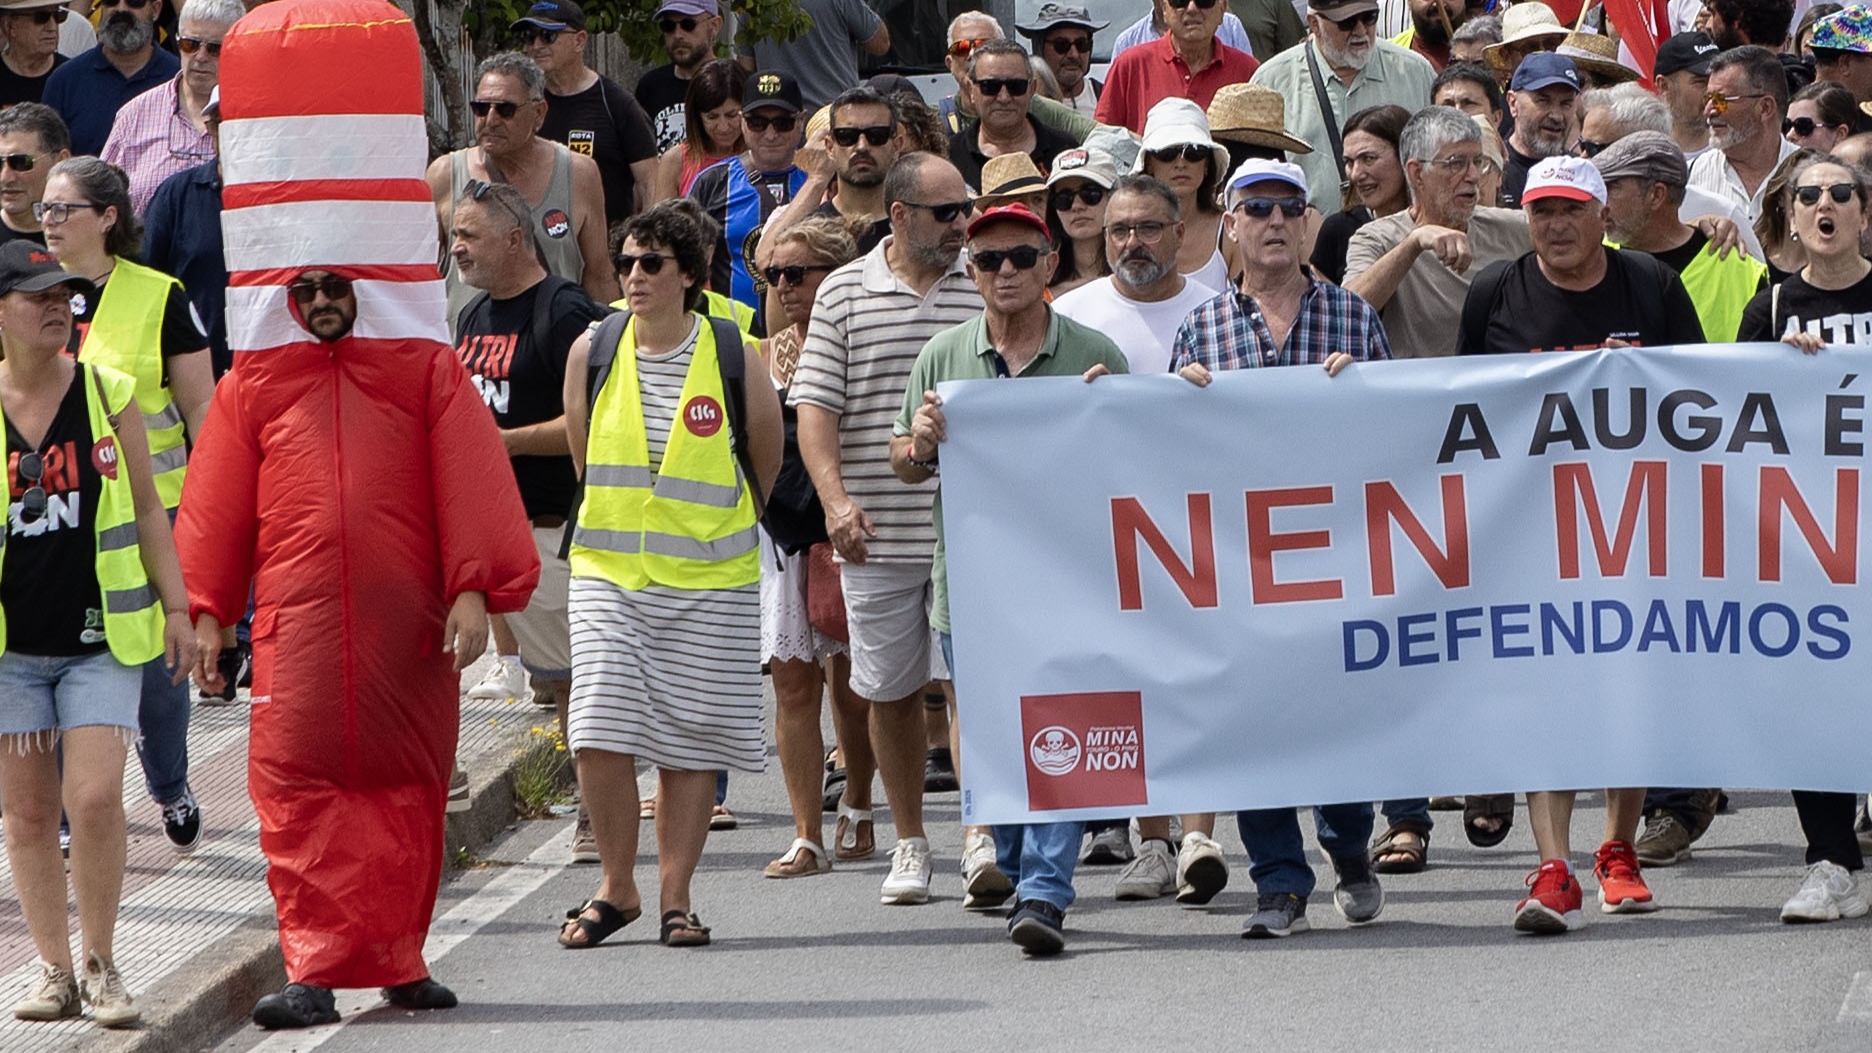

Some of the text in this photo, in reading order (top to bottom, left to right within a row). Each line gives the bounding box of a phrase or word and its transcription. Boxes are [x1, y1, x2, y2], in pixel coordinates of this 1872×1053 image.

[1437, 404, 1500, 464] A
[1528, 388, 1790, 456] AUGA
[1824, 375, 1865, 457] É
[1111, 475, 1469, 611] NEN
[1342, 599, 1851, 673] DEFENDAMOS
[1085, 751, 1138, 772] NON
[1086, 730, 1139, 746] MINA
